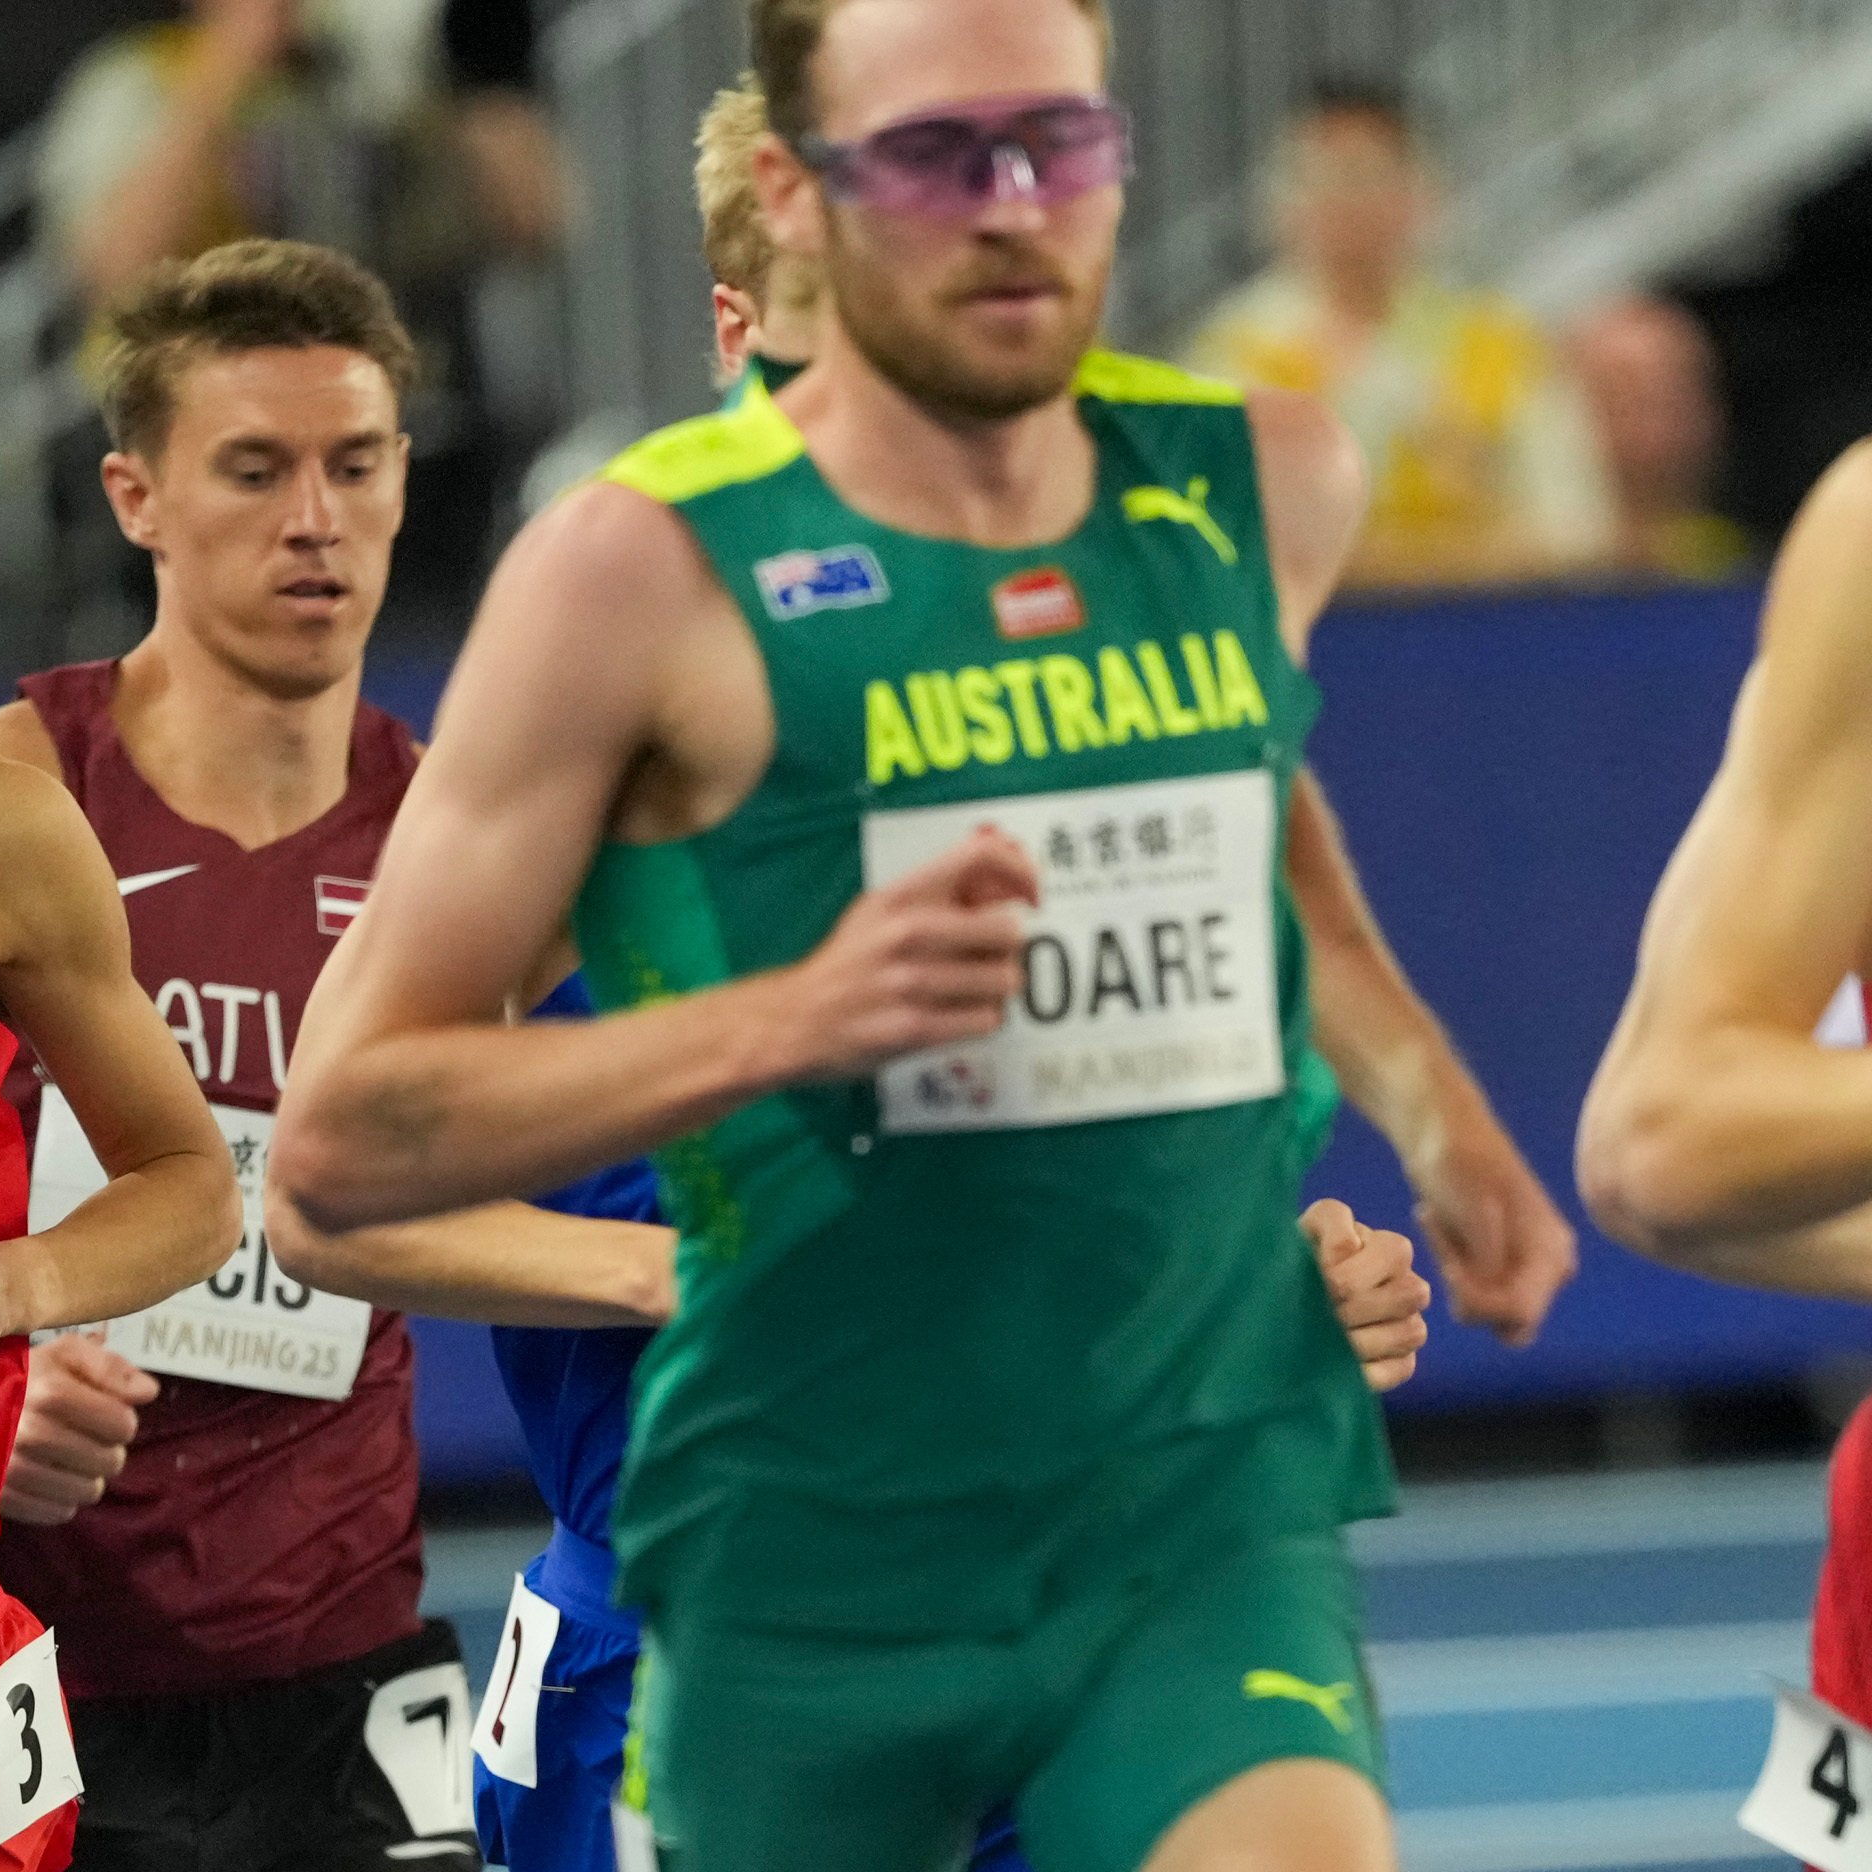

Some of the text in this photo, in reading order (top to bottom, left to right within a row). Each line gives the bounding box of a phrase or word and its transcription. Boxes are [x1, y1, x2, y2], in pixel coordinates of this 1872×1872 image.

[865, 628, 1268, 785] AUSTRALIA
[1024, 912, 1236, 1026] OARE
[5, 1682, 43, 1805] 3
[1810, 1724, 1858, 1838] 4
